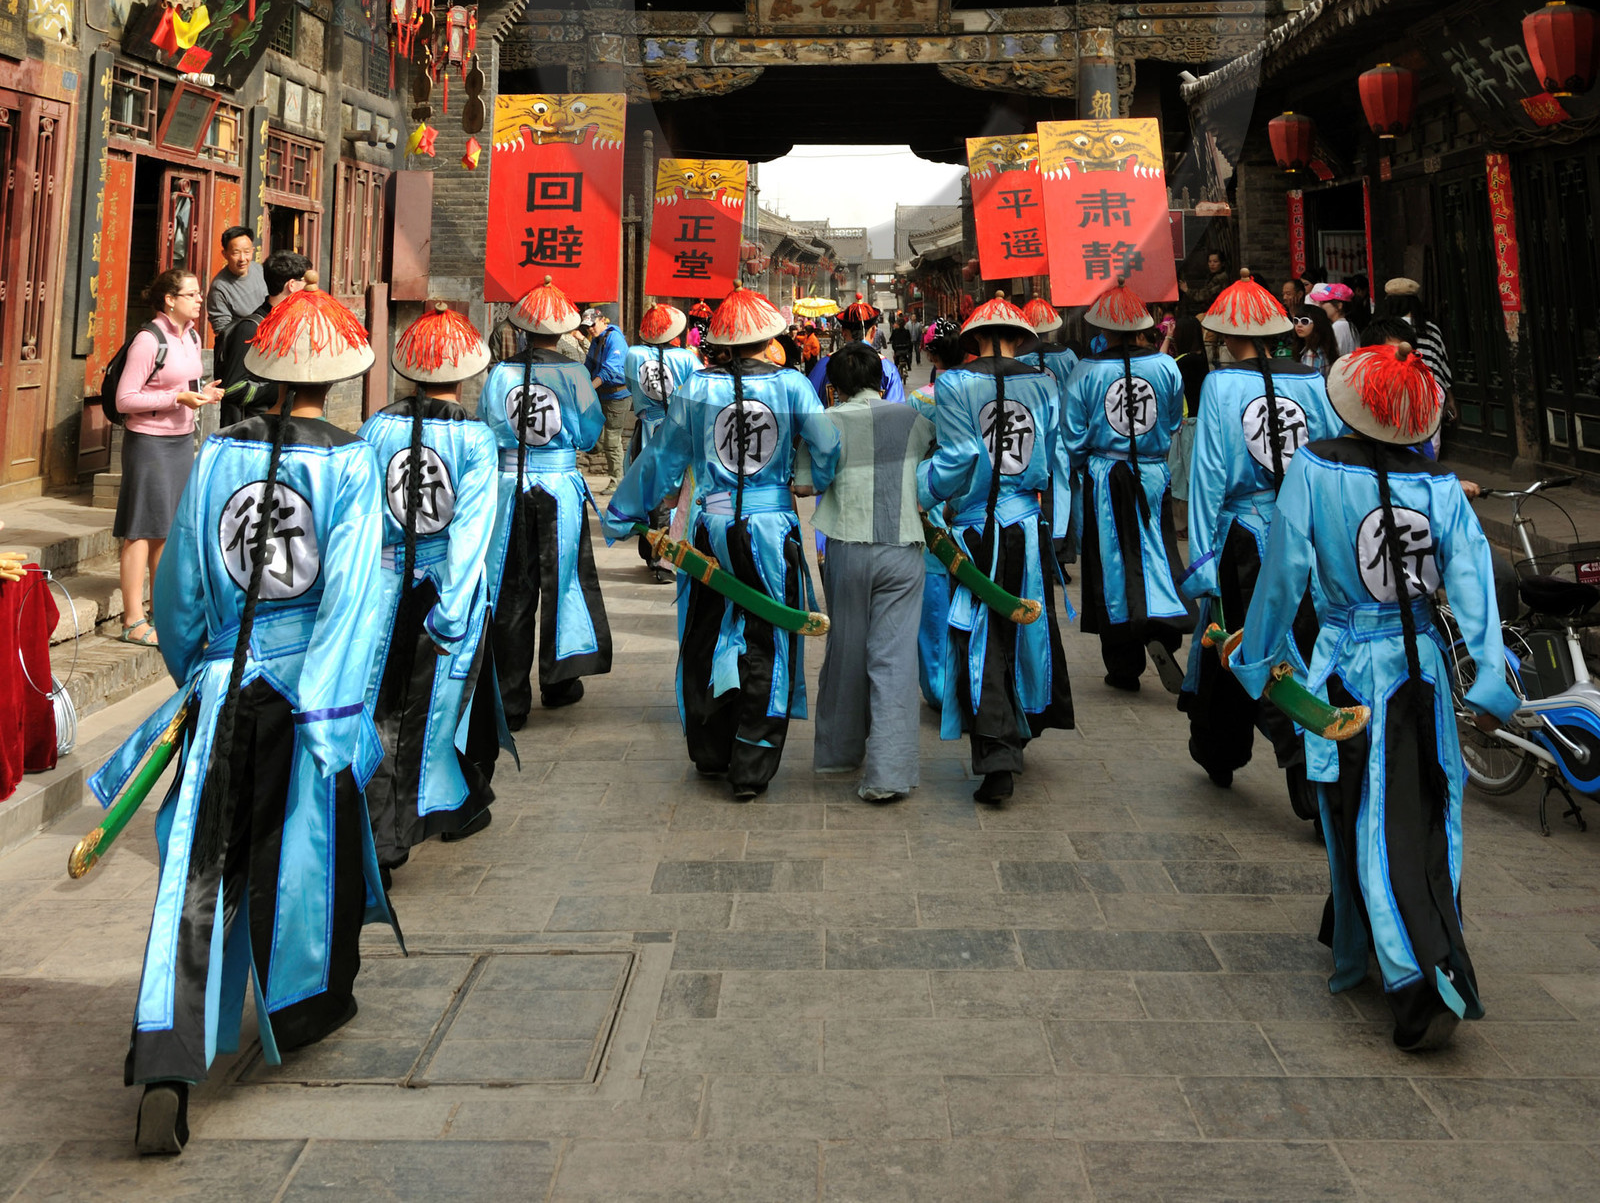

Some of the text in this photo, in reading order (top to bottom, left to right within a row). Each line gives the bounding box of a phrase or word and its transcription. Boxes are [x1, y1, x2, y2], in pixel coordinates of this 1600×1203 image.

[1441, 28, 1533, 110] 和祥
[518, 171, 584, 269] 回避
[672, 215, 716, 280] 正堂
[997, 188, 1045, 260] 平遥
[1075, 188, 1146, 281] 肃静
